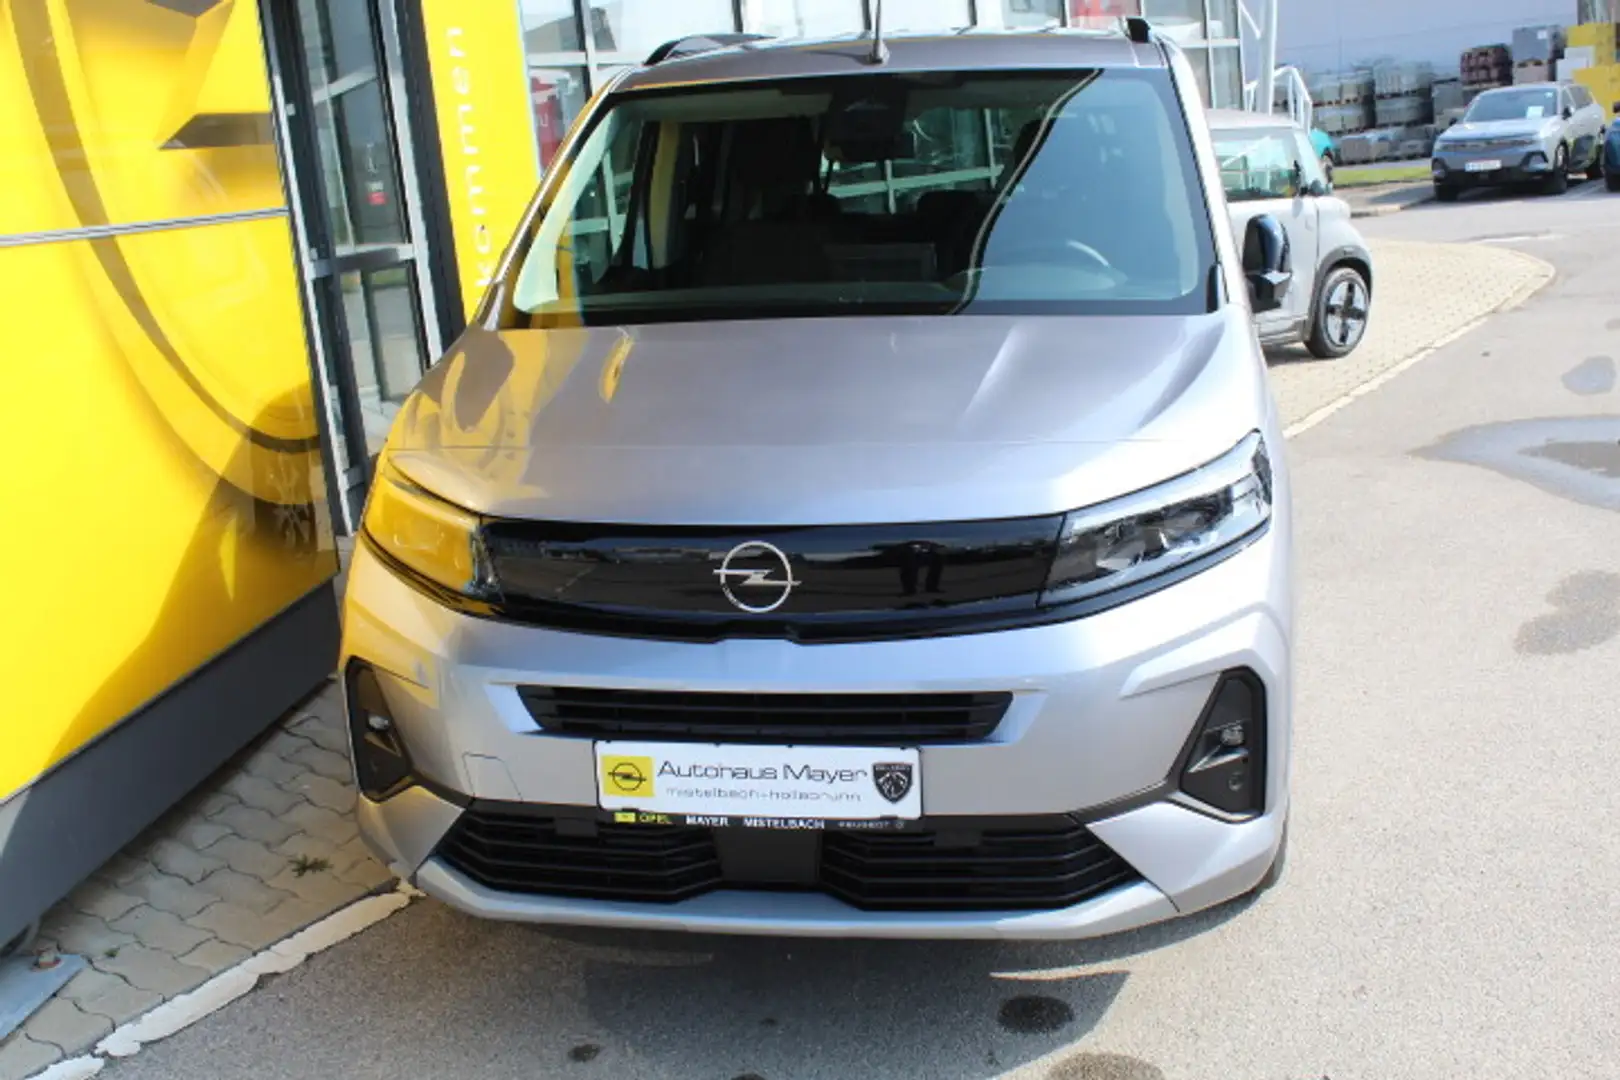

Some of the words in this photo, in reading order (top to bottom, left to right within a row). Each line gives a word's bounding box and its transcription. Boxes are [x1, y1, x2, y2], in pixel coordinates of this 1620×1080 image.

[657, 760, 777, 780] Autohaus
[782, 764, 867, 784] Mayer
[686, 815, 729, 827] MAYER
[743, 817, 825, 829] MISTELBACH
